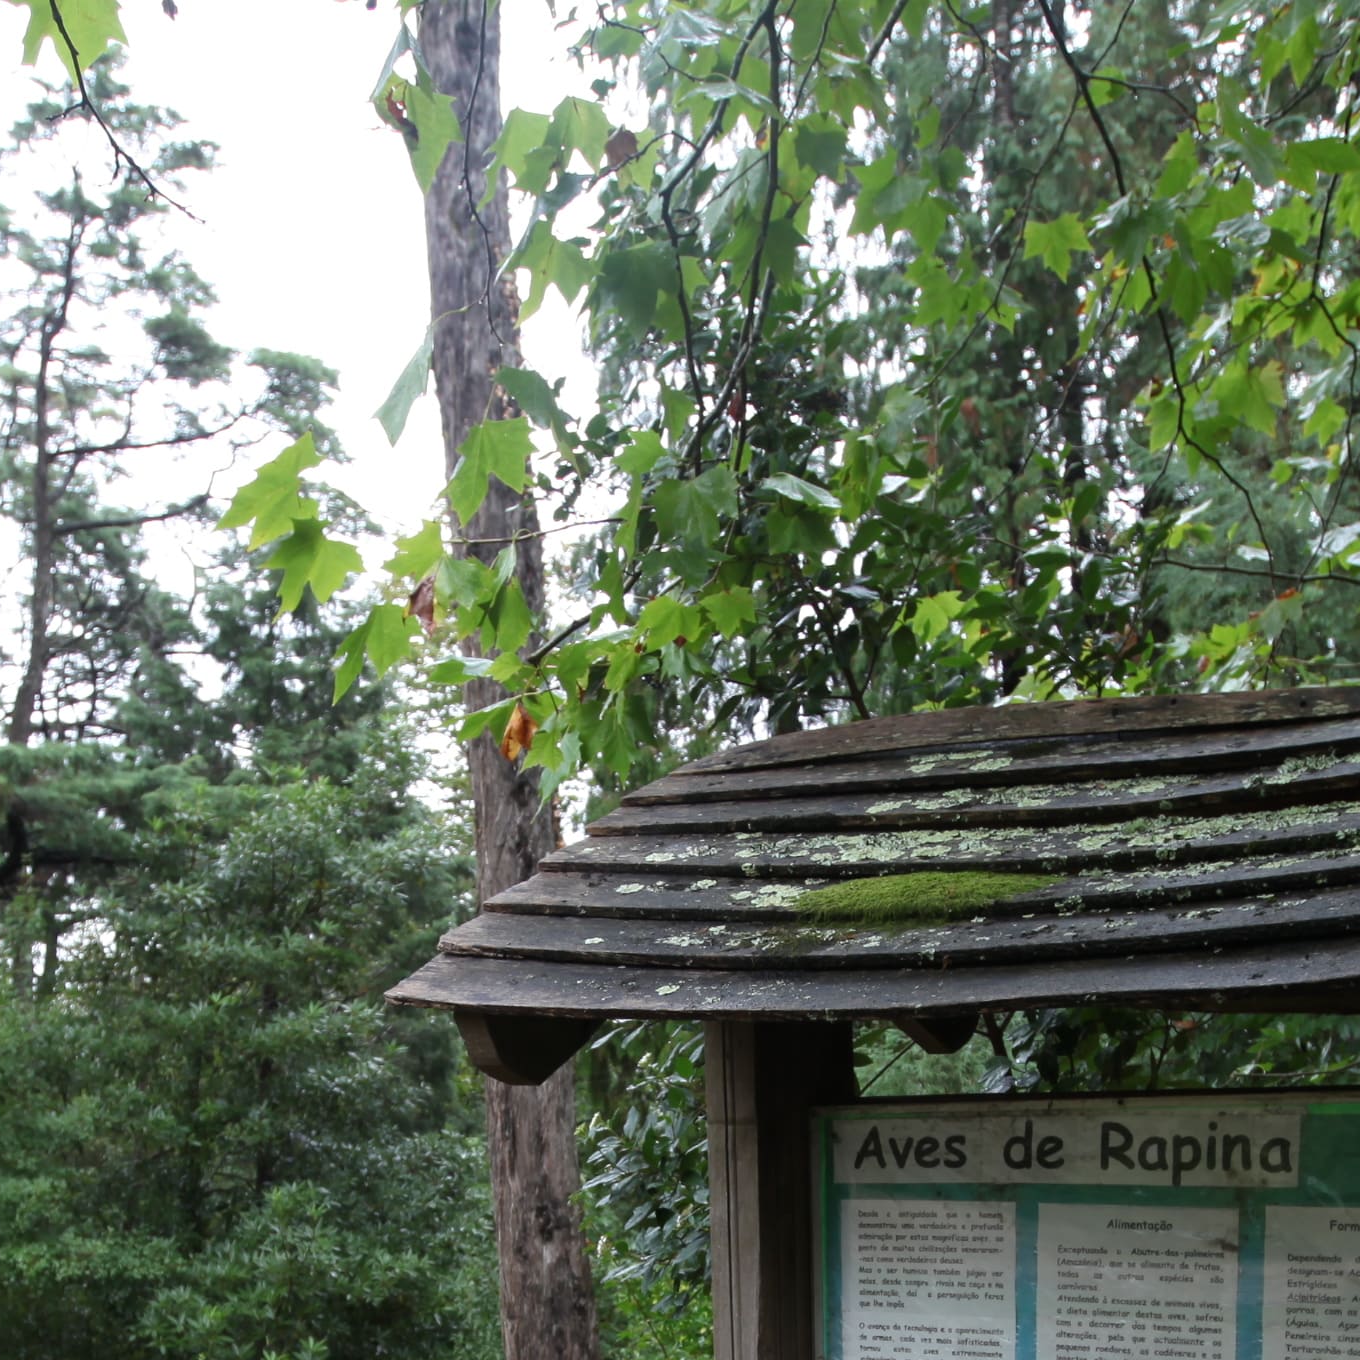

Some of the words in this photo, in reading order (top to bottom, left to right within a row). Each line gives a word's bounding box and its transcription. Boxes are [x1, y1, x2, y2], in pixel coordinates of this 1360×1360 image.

[854, 1126, 967, 1170] Aves
[1003, 1121, 1064, 1170] de
[1100, 1121, 1292, 1187] Rapina
[1107, 1219, 1172, 1232] Alimentação
[1067, 1307, 1087, 1315] dieta
[1195, 1313, 1223, 1322] sofreu
